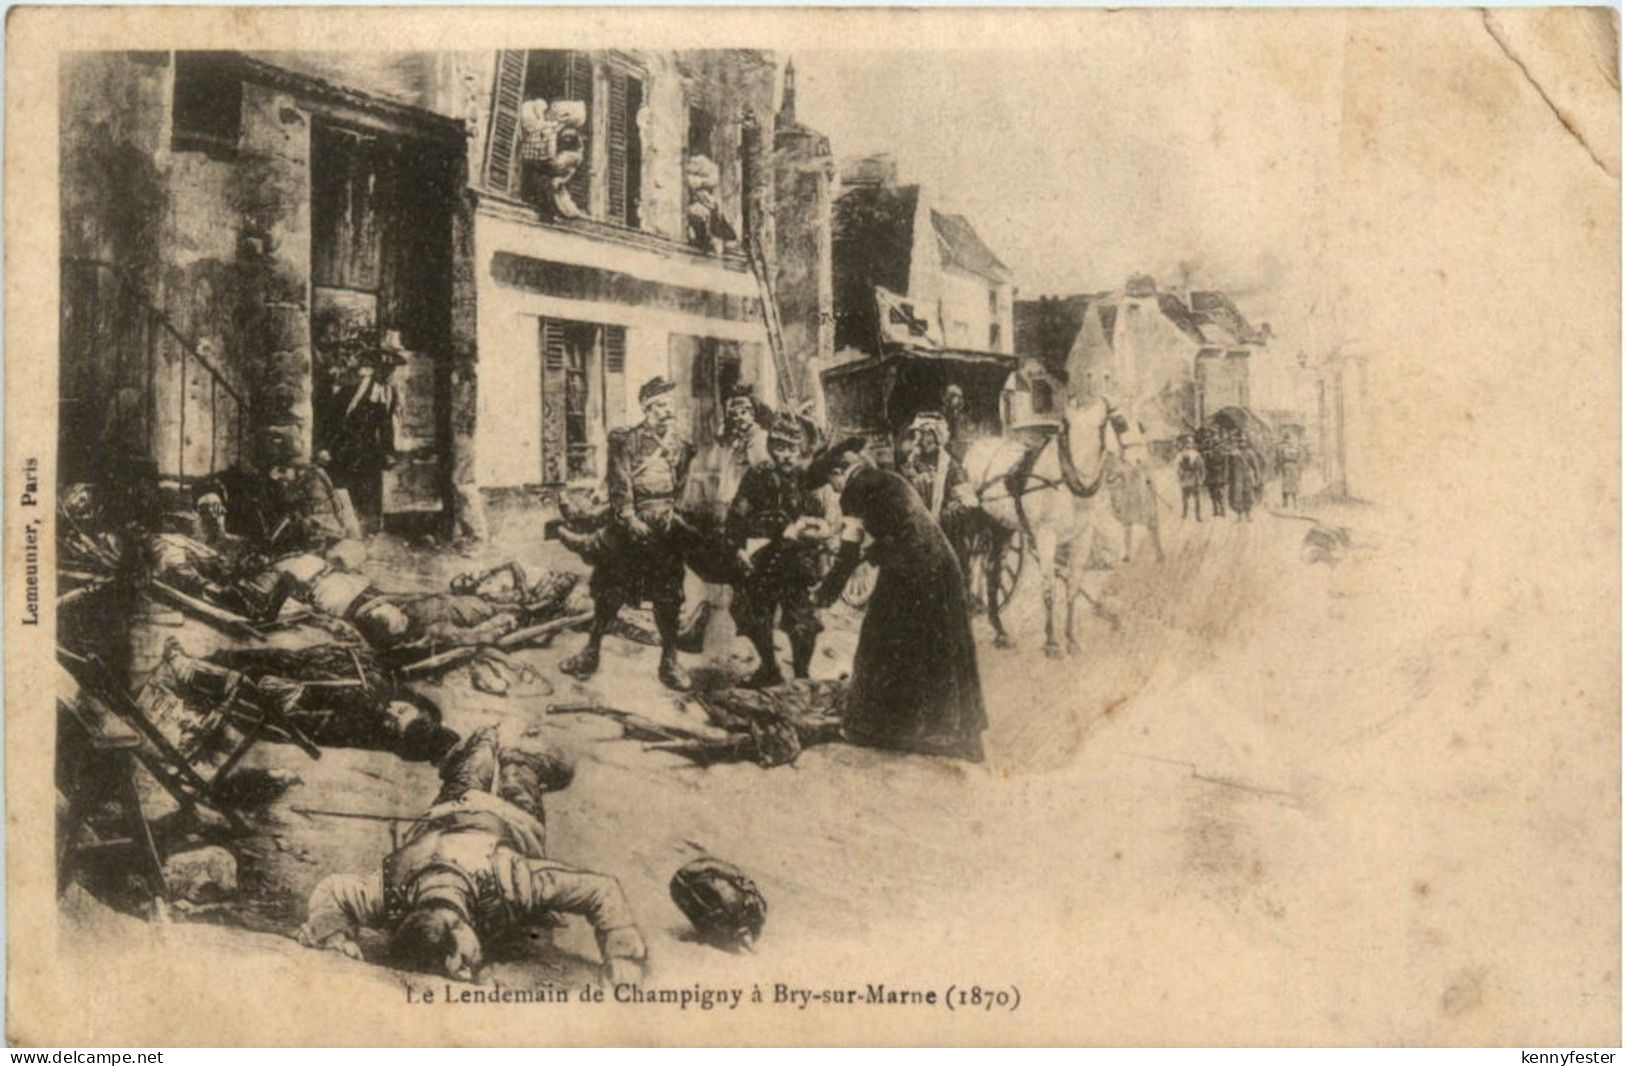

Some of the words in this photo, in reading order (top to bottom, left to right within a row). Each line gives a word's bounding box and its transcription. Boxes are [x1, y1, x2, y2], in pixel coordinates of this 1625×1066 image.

[21, 457, 38, 507] Paris
[22, 519, 41, 627] Lemeunier,
[406, 985, 434, 1004] Le
[445, 984, 569, 1004] Lendemain
[579, 984, 604, 1004] de
[613, 983, 742, 1010] Champigny
[750, 984, 763, 1003] à
[773, 984, 937, 1010] Bry-sur-Marne
[945, 985, 1021, 1011] (1870)
